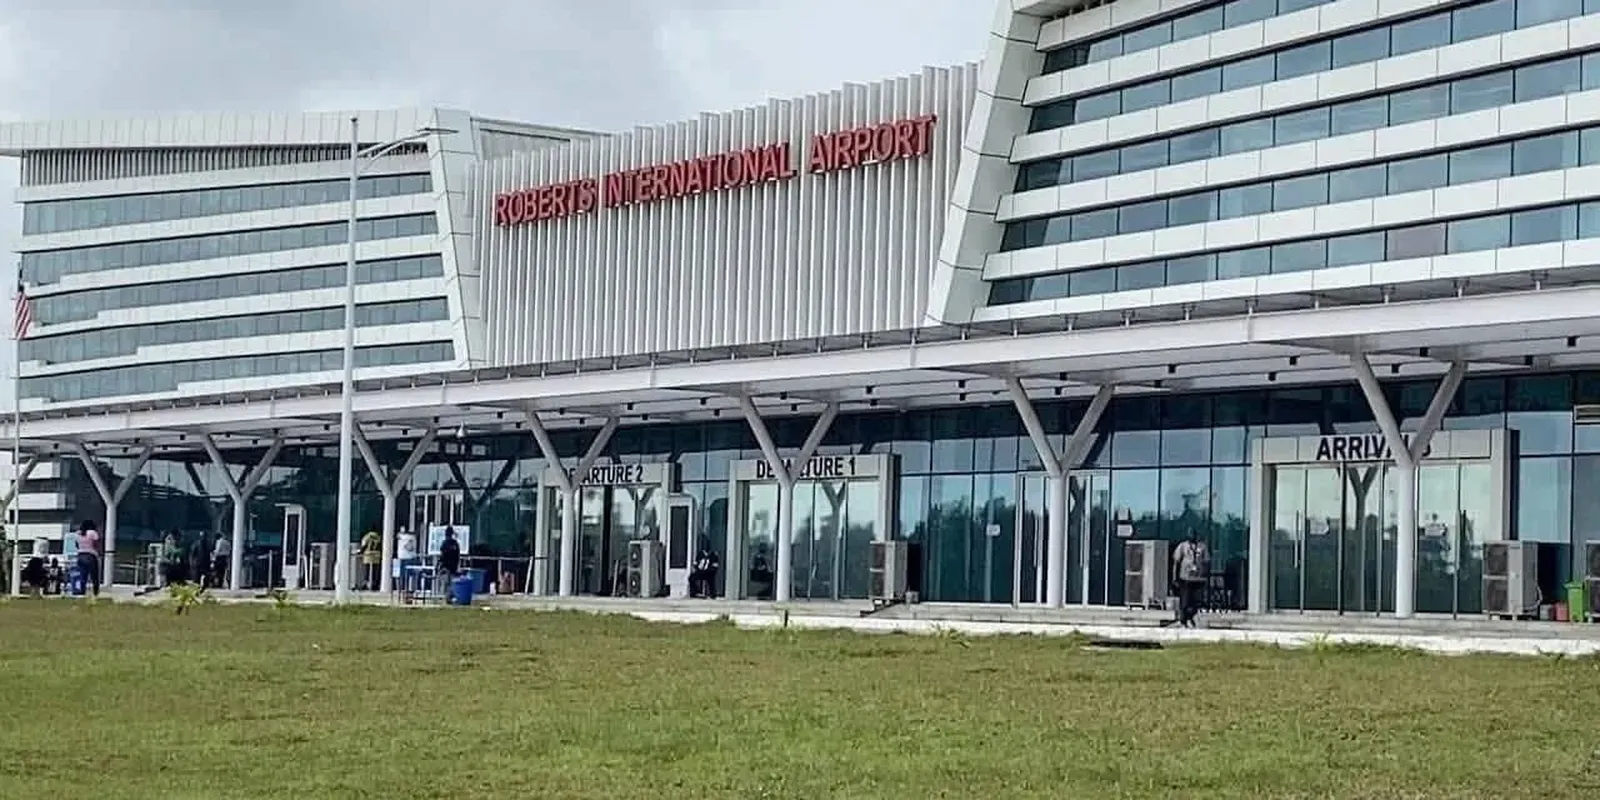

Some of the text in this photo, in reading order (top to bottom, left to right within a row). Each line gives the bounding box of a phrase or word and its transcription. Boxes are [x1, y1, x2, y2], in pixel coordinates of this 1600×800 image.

[496, 113, 937, 225] ROBERTS INTERNATIONAL AIRPORT
[636, 465, 643, 482] 2
[848, 456, 855, 475] 1
